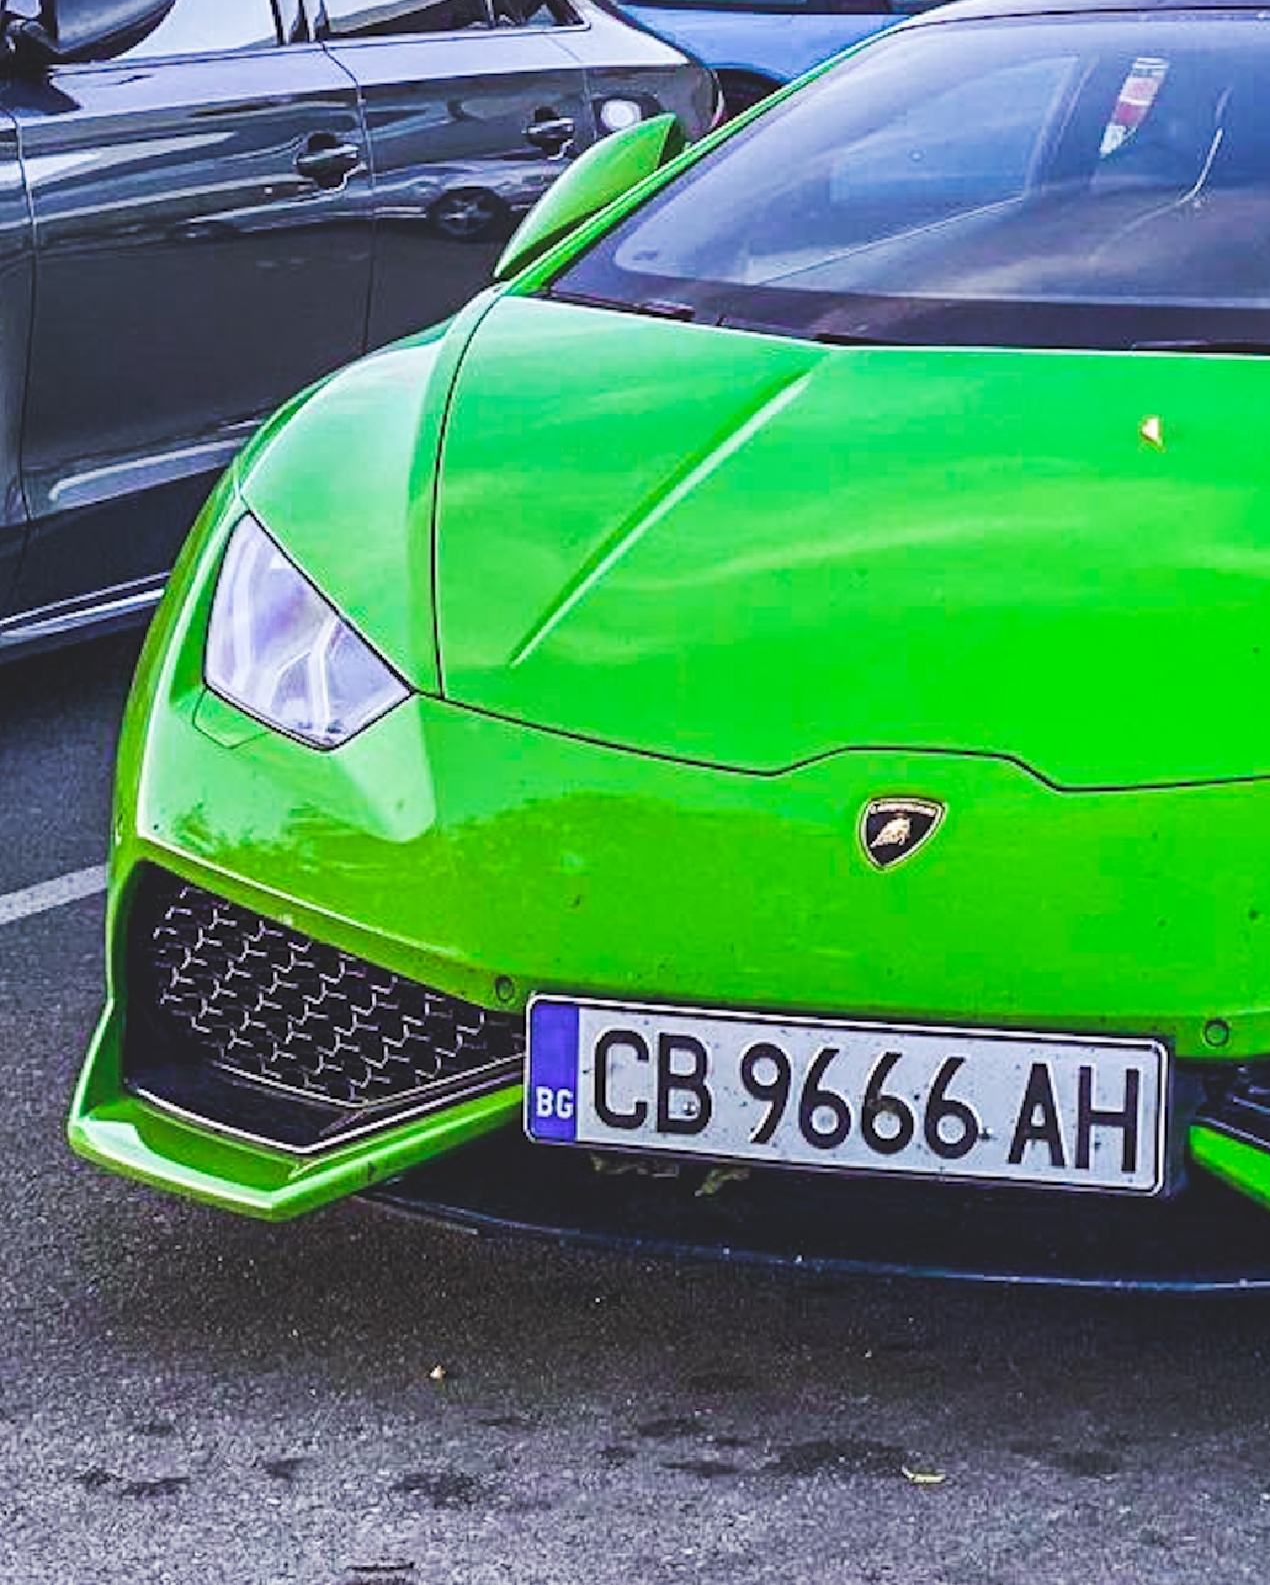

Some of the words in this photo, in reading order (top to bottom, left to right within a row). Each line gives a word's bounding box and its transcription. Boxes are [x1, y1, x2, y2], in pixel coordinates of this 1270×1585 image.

[535, 1086, 573, 1119] BG
[593, 1028, 712, 1136] CB
[739, 1041, 983, 1160] 9666
[1006, 1062, 1140, 1175] AH
